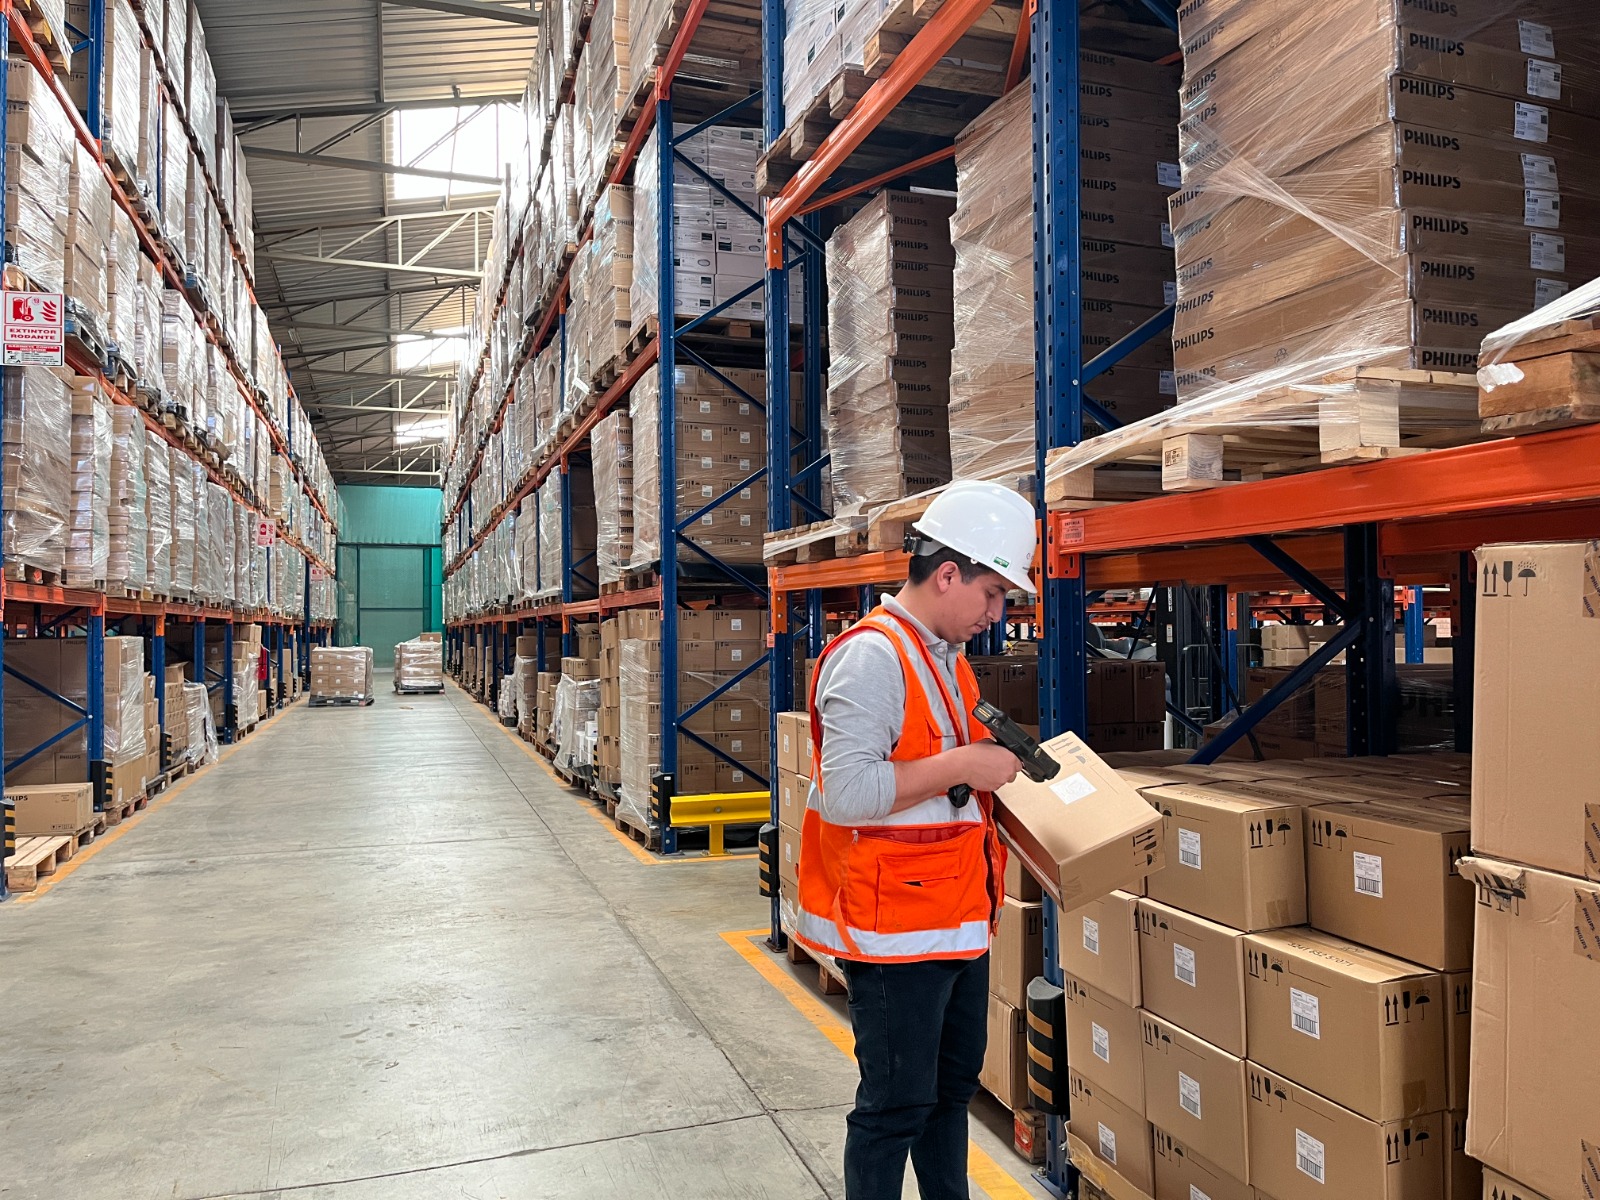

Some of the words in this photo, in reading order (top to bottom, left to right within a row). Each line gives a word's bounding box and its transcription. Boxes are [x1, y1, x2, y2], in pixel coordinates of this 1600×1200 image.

[1180, 0, 1207, 21] PHIL
[1185, 22, 1225, 55] PHILIPS
[1410, 33, 1464, 56] PHILIPS
[1080, 52, 1116, 66] HILIPS
[1080, 85, 1112, 97] HILIPS
[1400, 78, 1455, 100] PHILIPS
[1404, 129, 1460, 150] PHILIPS
[1081, 149, 1111, 162] HILIPS
[1082, 179, 1117, 191] HILIPS
[1403, 170, 1461, 189] PHILIPS
[894, 216, 928, 227] PHILIPS
[1081, 211, 1115, 224] HILIPS
[1413, 215, 1468, 235] PHILIPS
[895, 240, 929, 250] PHILIPS
[1082, 242, 1116, 253] HILIPS
[896, 262, 929, 271] PHILIPS
[1421, 261, 1475, 281] PHILIPS
[897, 288, 931, 298] PHILIPS
[1082, 302, 1113, 313] HILIPS
[1177, 290, 1214, 314] PHILIPS
[895, 312, 929, 321] PHILIPS
[1423, 308, 1478, 327] PHILIPS
[900, 333, 933, 341] PHILIPS
[1174, 328, 1215, 352] PHILIPS
[894, 359, 927, 368] PHILIPS
[1177, 365, 1217, 386] PHILIPS
[898, 383, 931, 392] PHILIPS
[901, 407, 934, 416] PHILIPS
[902, 429, 935, 437] PHILIPS
[1583, 907, 1595, 931] PHILIPS
[1575, 926, 1587, 949] PHILIPS
